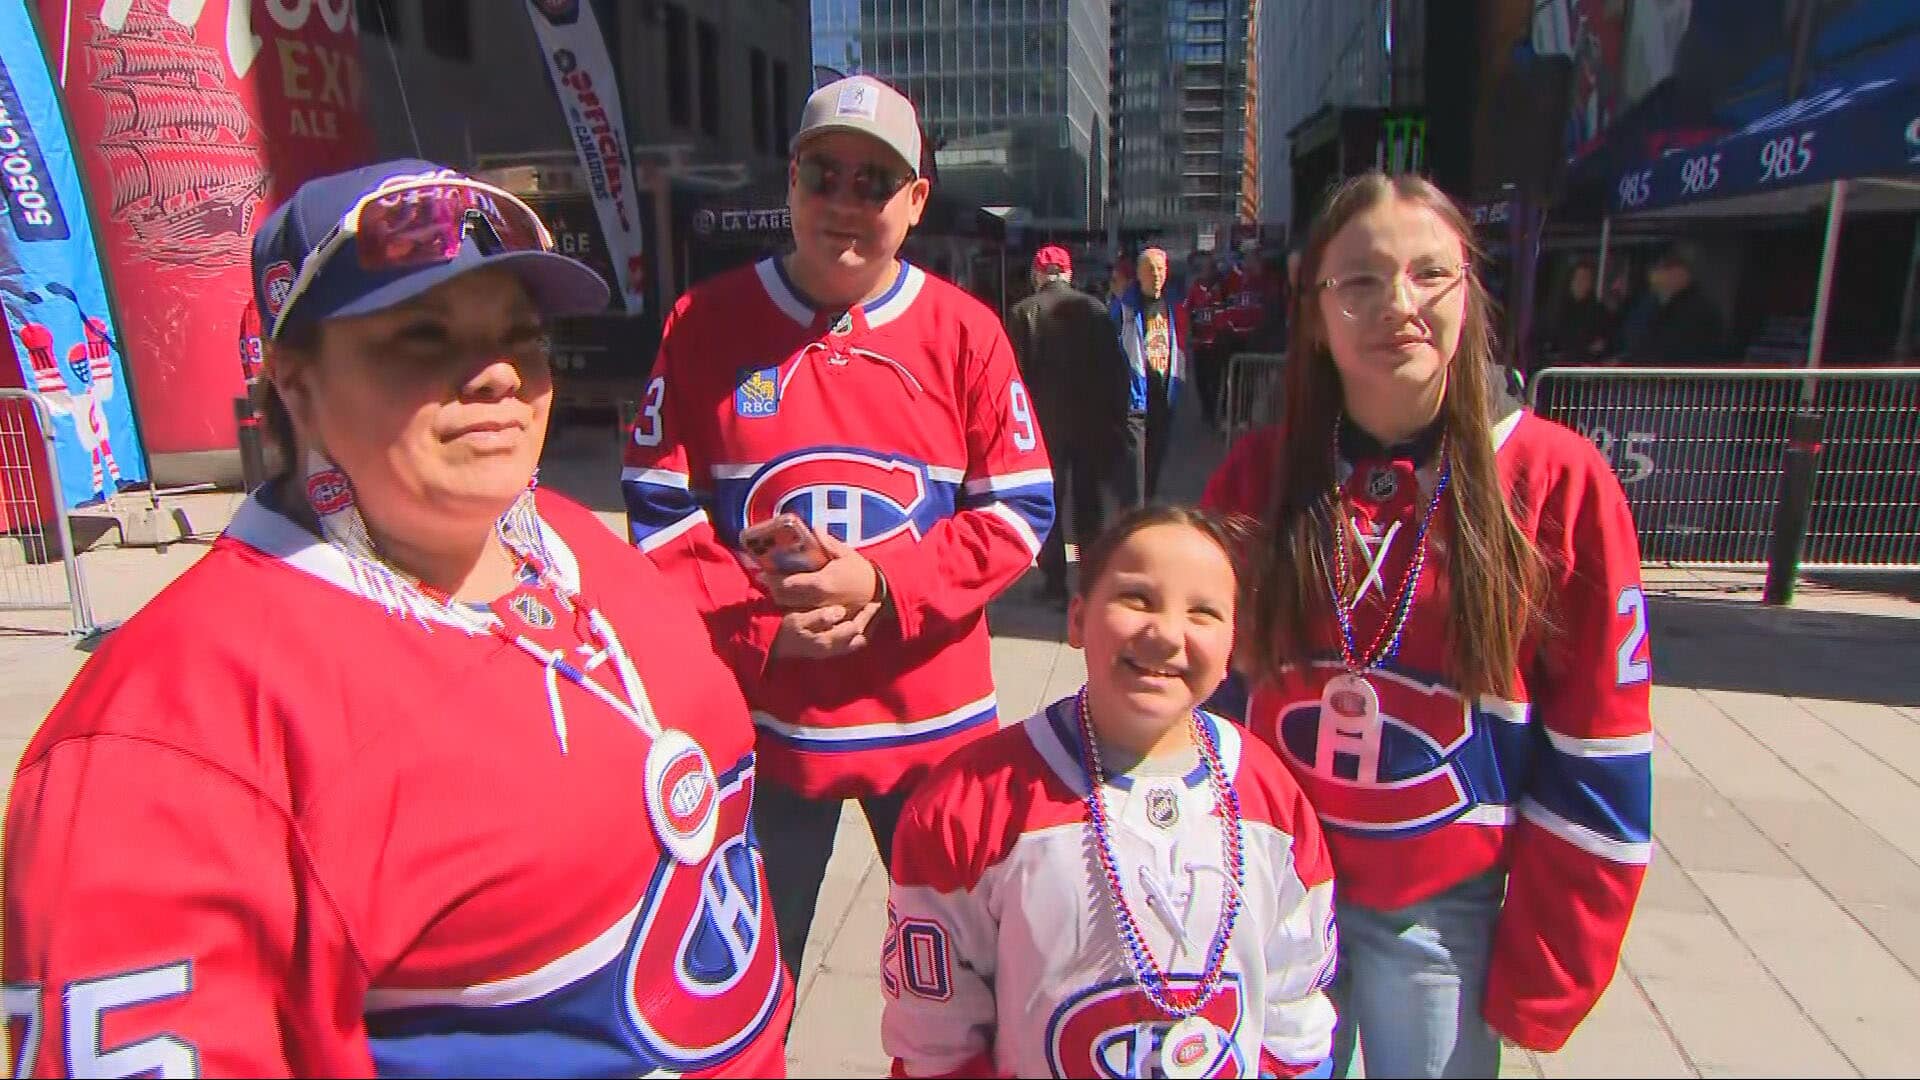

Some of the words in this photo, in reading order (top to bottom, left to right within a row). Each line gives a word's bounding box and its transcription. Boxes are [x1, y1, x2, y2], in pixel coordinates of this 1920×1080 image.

[290, 109, 338, 138] ALE
[721, 217, 742, 231] LA
[746, 215, 791, 230] CAGE
[634, 376, 666, 448] 3
[742, 401, 774, 414] RBC
[1009, 380, 1038, 453] 9
[1615, 585, 1650, 688] 2
